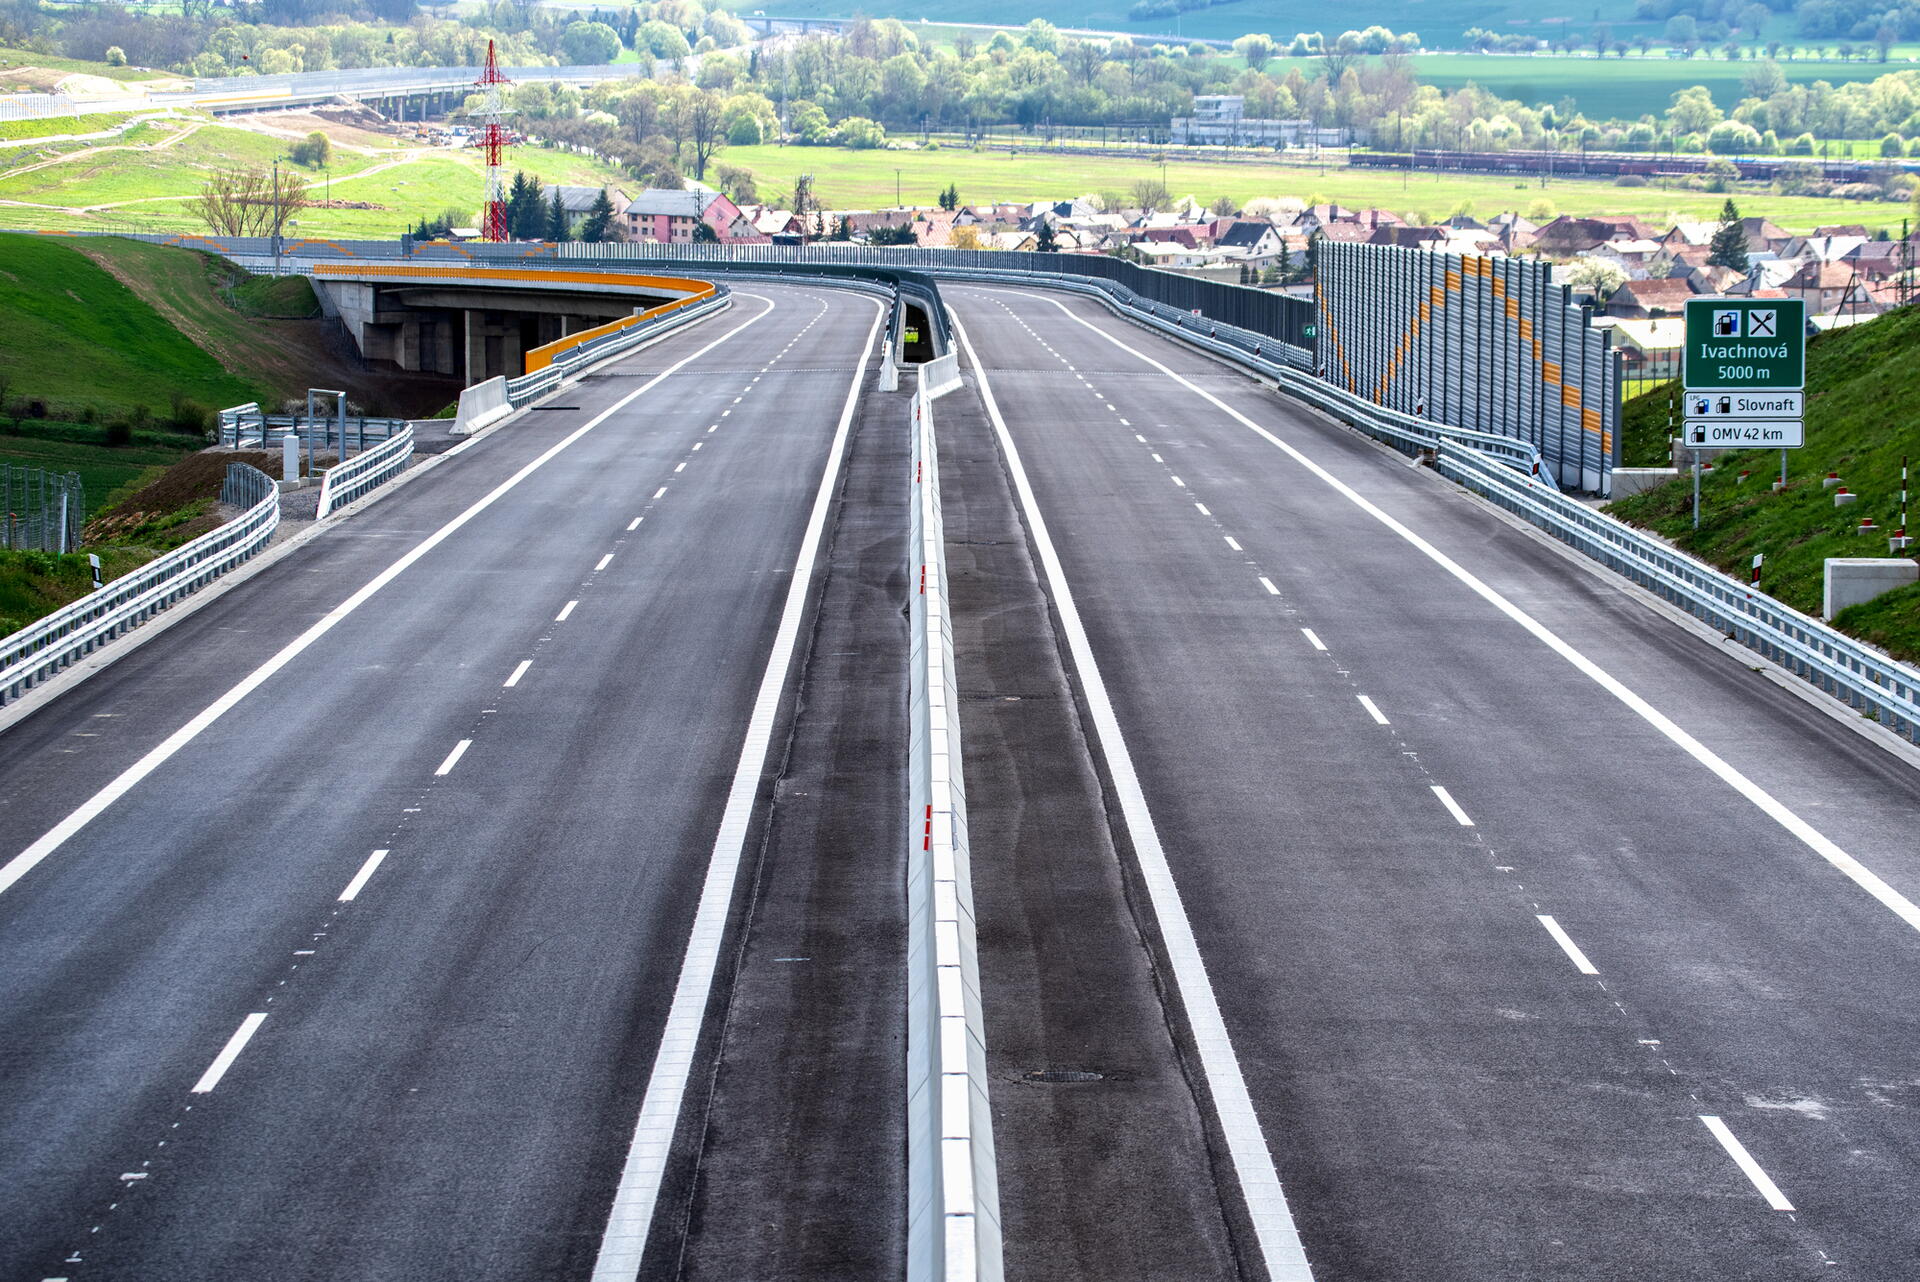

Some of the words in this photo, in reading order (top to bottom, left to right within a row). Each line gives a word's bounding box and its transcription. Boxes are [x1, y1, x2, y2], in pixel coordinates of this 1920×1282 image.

[1701, 342, 1788, 359] Ivachnová
[1718, 365, 1754, 379] 5000
[1757, 368, 1770, 379] m
[1737, 398, 1795, 411] Slovnaft
[1712, 428, 1742, 440] OMV
[1743, 428, 1760, 440] 42
[1763, 428, 1783, 440] km
